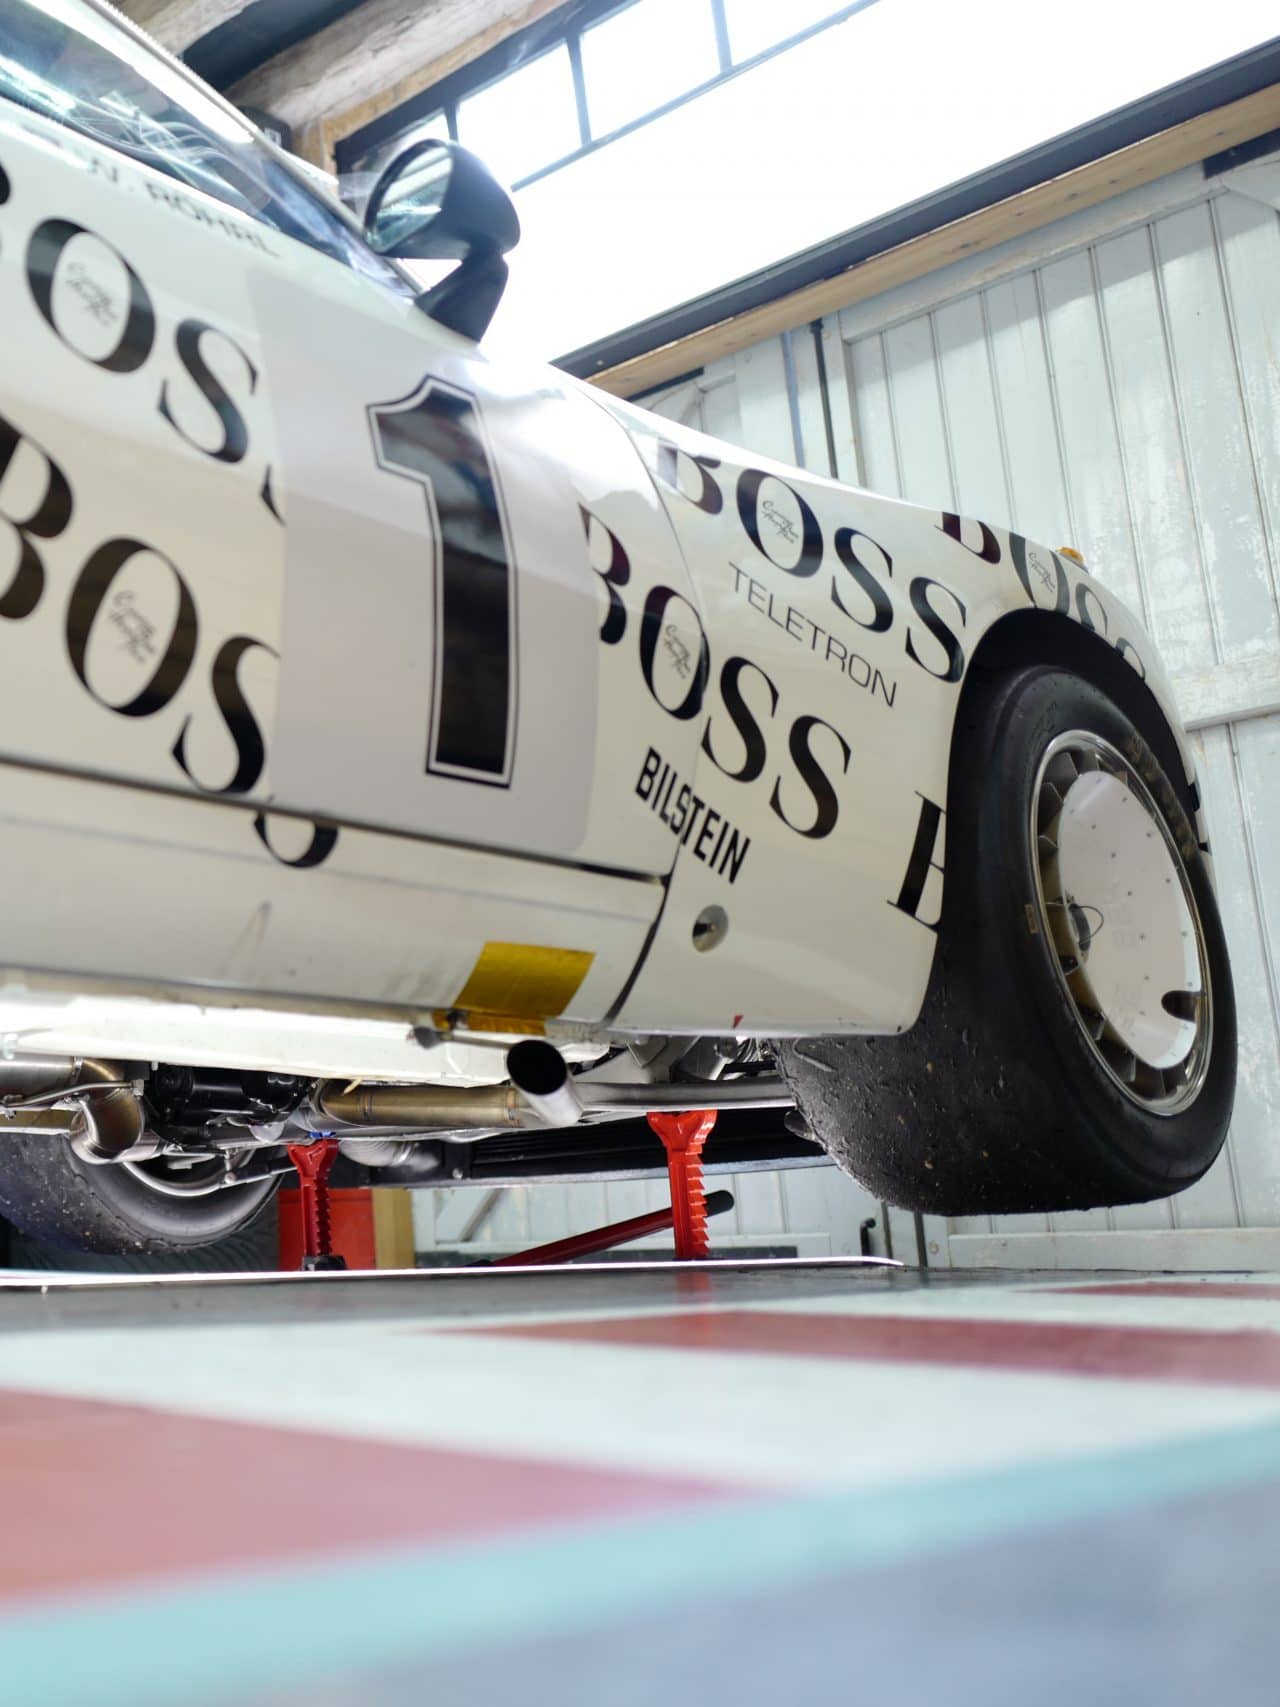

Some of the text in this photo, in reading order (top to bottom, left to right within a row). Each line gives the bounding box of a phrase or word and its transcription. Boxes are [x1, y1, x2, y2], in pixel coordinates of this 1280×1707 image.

[365, 374, 519, 790] 1
[656, 437, 967, 684] BOSS
[728, 561, 897, 708] TELETRON
[634, 746, 751, 885] BILSTEIN
